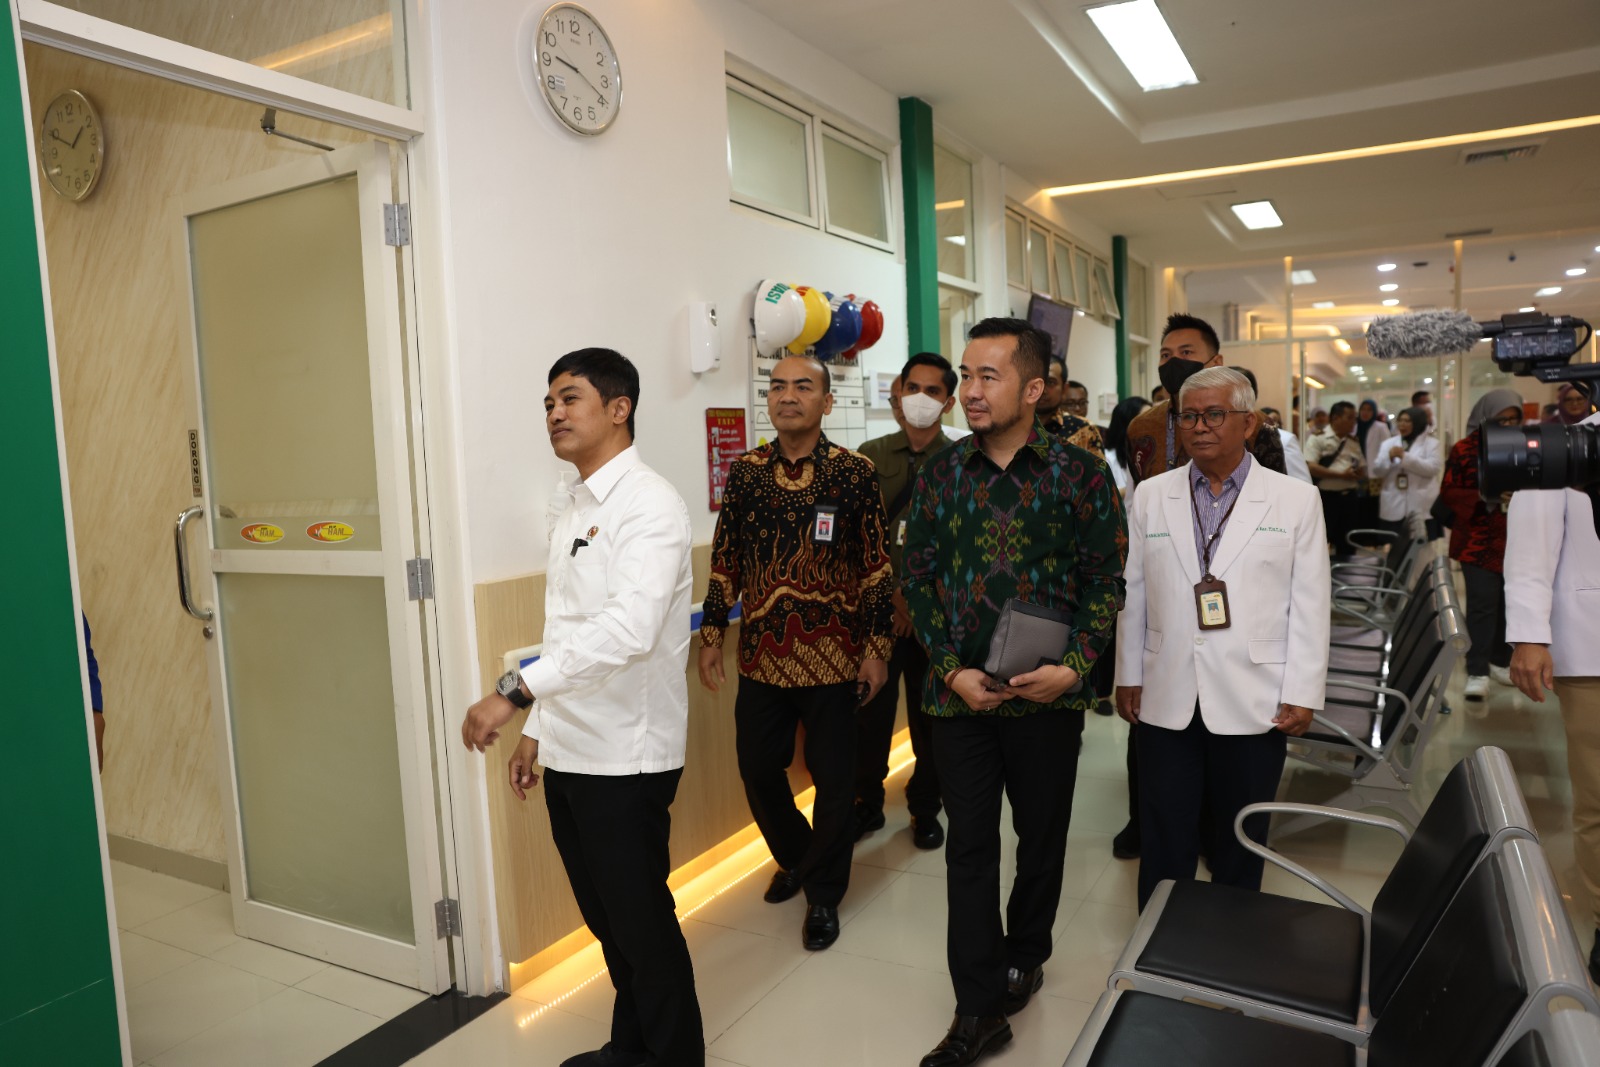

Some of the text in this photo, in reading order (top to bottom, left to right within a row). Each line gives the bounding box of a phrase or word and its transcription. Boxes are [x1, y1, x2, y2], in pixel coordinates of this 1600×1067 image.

[556, 19, 564, 34] 11
[569, 20, 580, 36] 12
[544, 31, 557, 48] 10
[588, 32, 592, 46] 1
[542, 52, 551, 66] 9
[596, 52, 604, 67] 2
[547, 75, 556, 90] 8
[600, 75, 608, 88] 3
[560, 95, 568, 110] 7
[597, 95, 606, 107] 4
[65, 103, 73, 115] 12
[573, 107, 582, 121] 6
[588, 106, 596, 120] 5
[57, 110, 63, 122] 11
[86, 115, 92, 128] 2
[90, 134, 96, 146] 3
[52, 147, 58, 159] 9
[89, 153, 95, 164] 4
[65, 175, 71, 187] 7
[83, 170, 90, 182] 5
[75, 177, 81, 189] 6
[190, 432, 199, 484] DORONG
[260, 529, 274, 537] HAM
[328, 528, 344, 536] HAM
